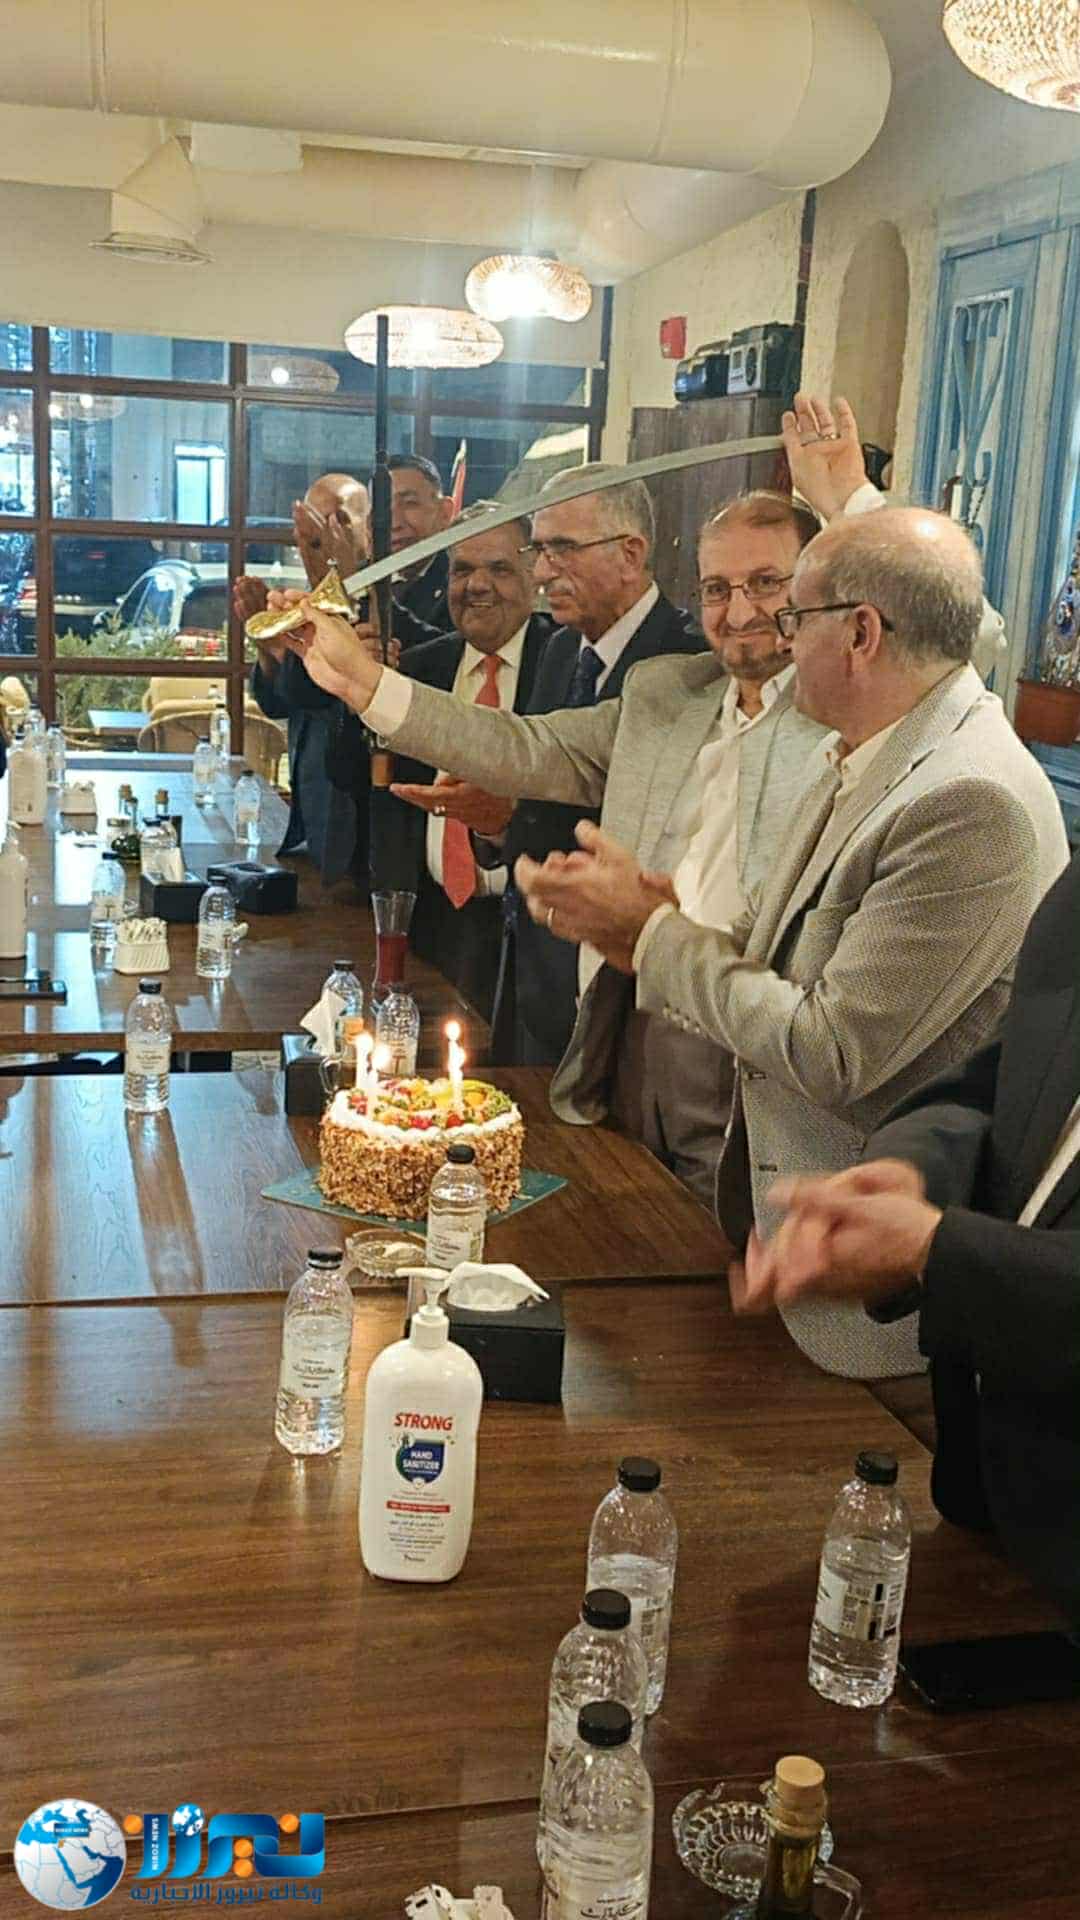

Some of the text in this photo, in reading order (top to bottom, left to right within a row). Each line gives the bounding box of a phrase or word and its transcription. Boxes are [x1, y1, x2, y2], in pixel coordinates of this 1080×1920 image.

[394, 1412, 453, 1431] STRONG
[410, 1450, 433, 1460] HAND
[402, 1459, 440, 1470] SANITIZER
